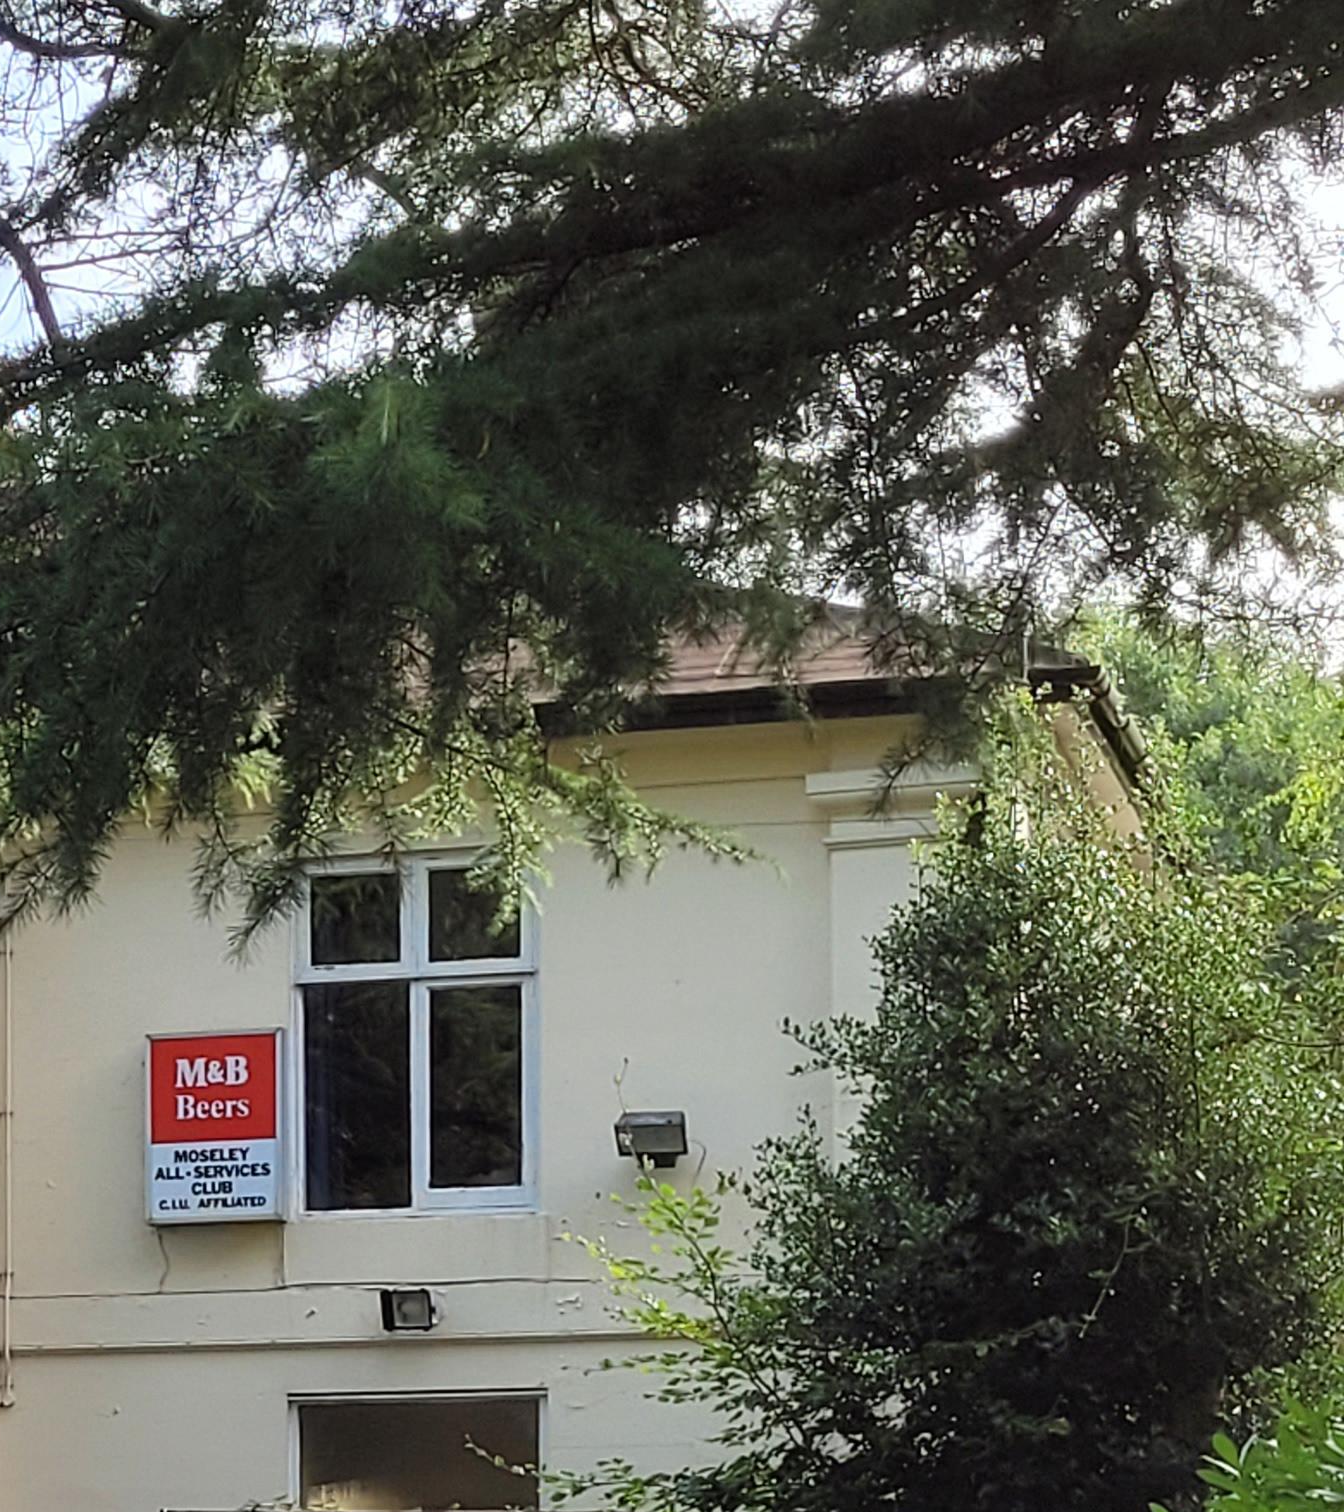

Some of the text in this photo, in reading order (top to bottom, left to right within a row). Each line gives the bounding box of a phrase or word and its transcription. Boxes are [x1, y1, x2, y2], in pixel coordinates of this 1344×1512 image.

[175, 1055, 249, 1088] M&B
[175, 1094, 250, 1120] Beers
[174, 1147, 250, 1164] MOSELEY
[191, 1181, 233, 1196] CLUB
[197, 1196, 267, 1209] AFFILIATED
